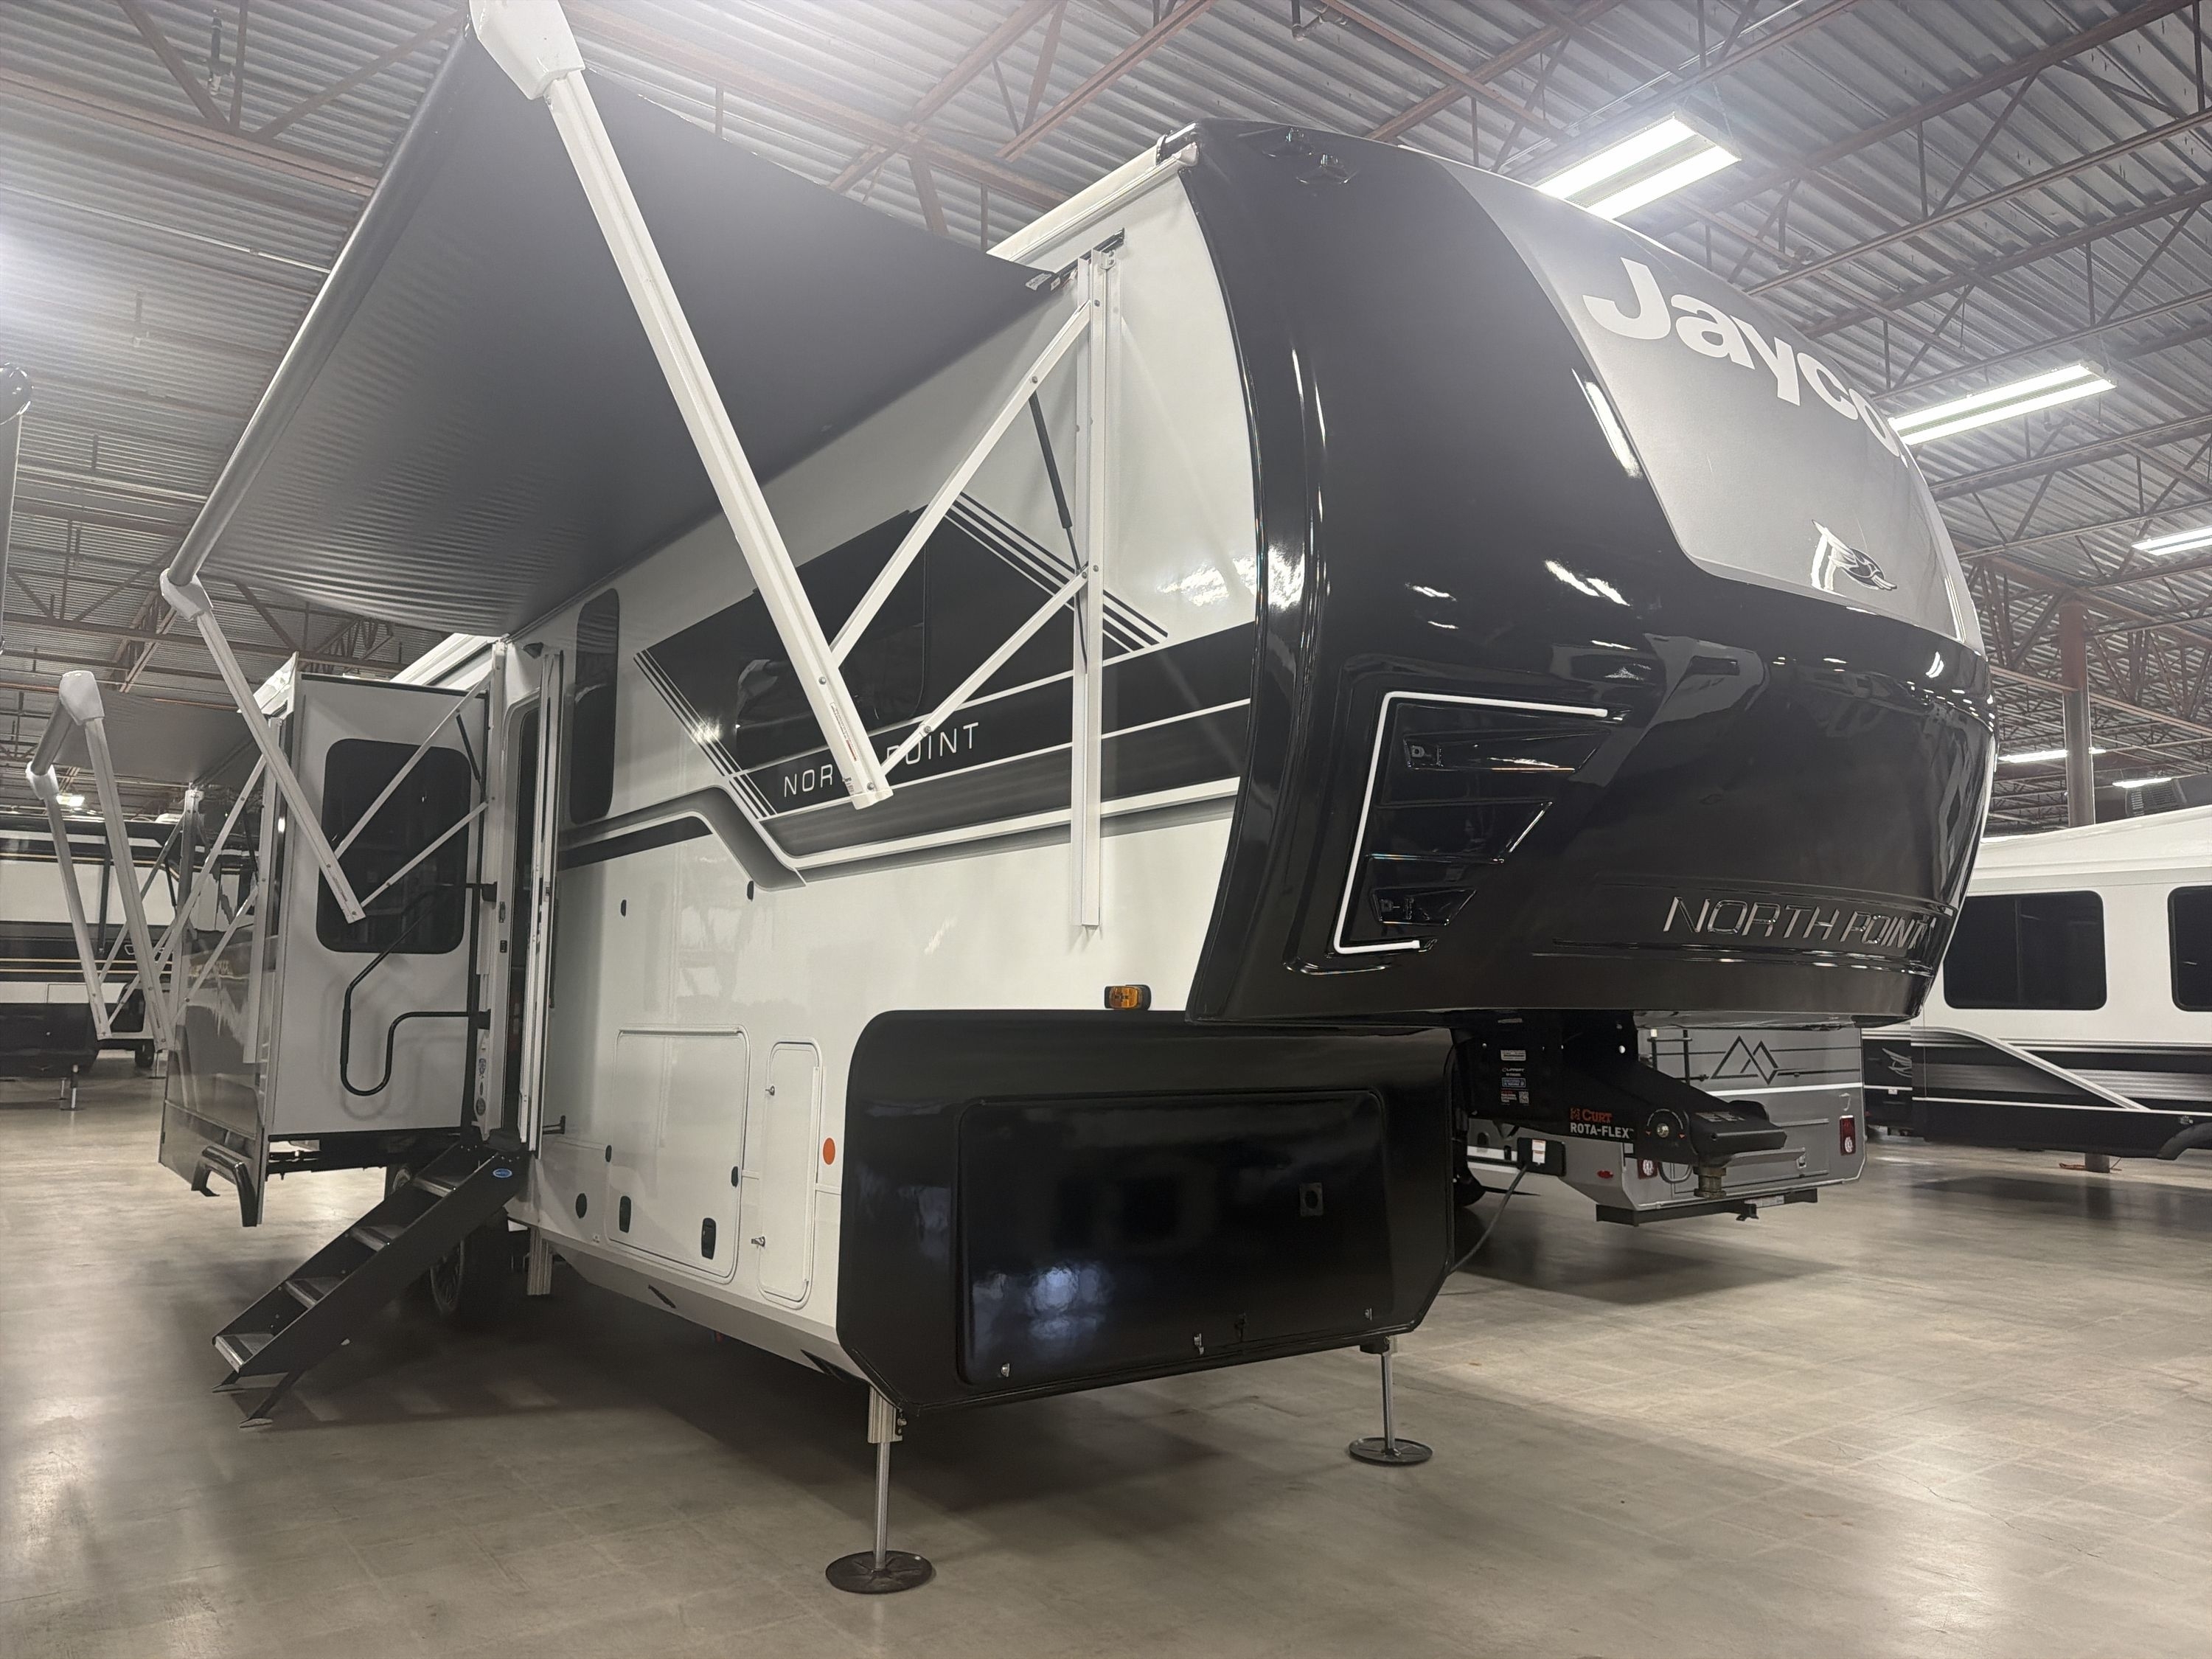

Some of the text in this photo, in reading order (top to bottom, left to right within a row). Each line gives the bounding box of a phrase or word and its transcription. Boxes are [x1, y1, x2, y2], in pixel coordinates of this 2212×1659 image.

[1582, 257, 1901, 458] Jayco
[784, 763, 845, 798] NOR
[1663, 896, 1929, 950] NORTH POINT
